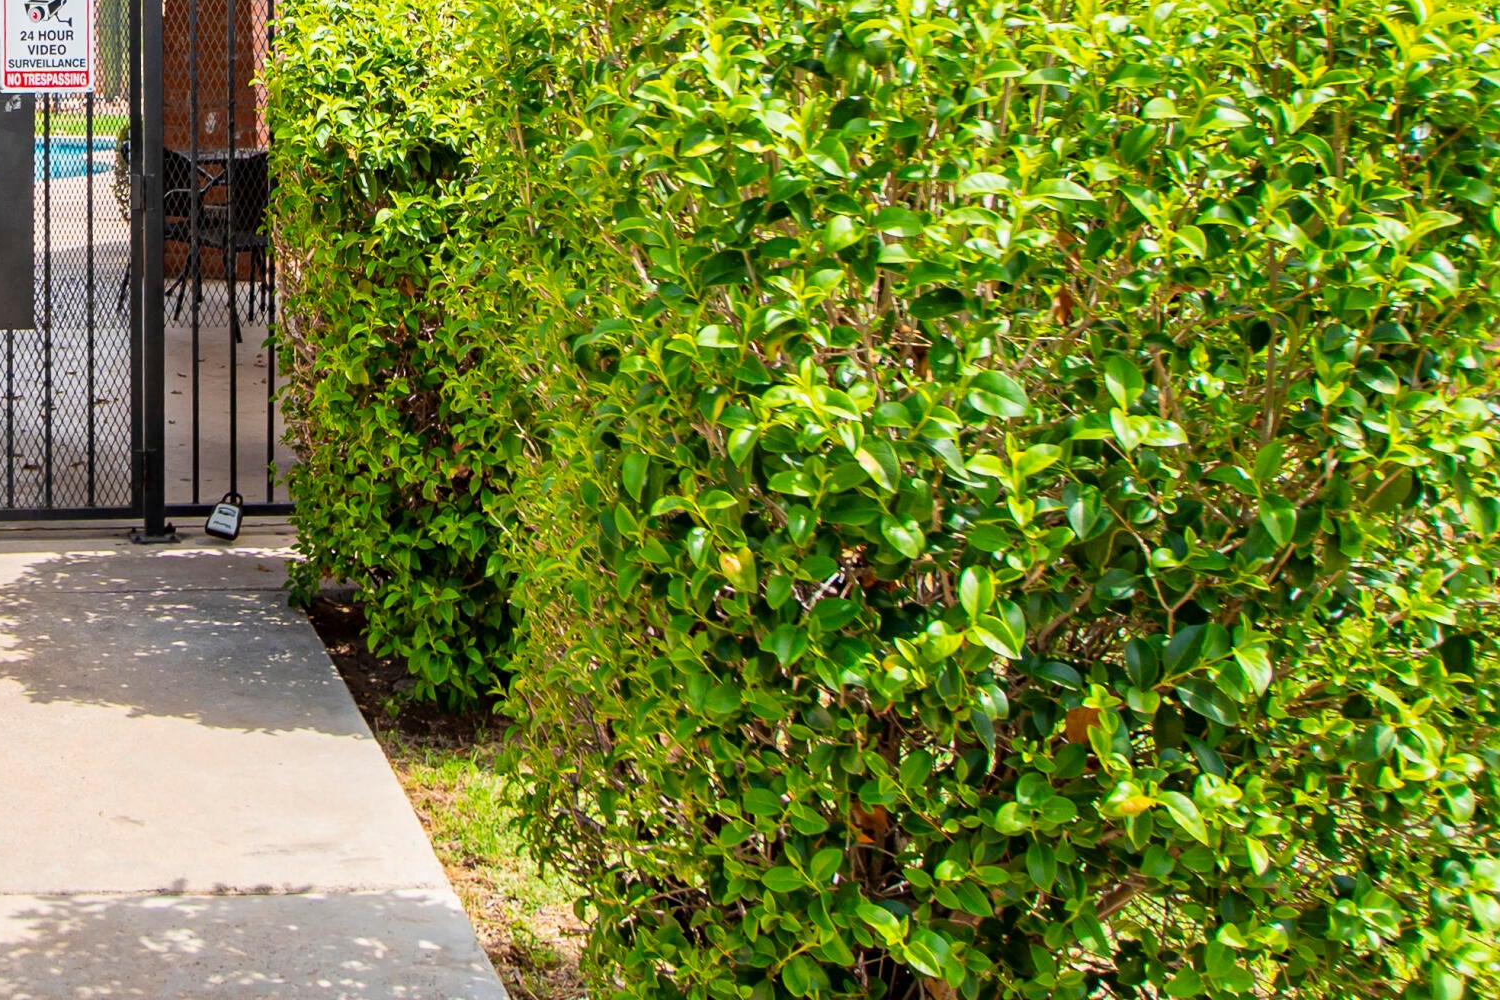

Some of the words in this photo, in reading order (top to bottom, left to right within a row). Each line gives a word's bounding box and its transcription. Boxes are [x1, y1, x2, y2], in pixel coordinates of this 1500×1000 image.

[20, 31, 34, 41] 24
[38, 30, 74, 41] HOUR
[28, 44, 66, 55] VIDEO
[8, 59, 86, 68] SURVEILLANCE
[7, 73, 21, 86] NO
[23, 73, 87, 86] TRESPASSING
